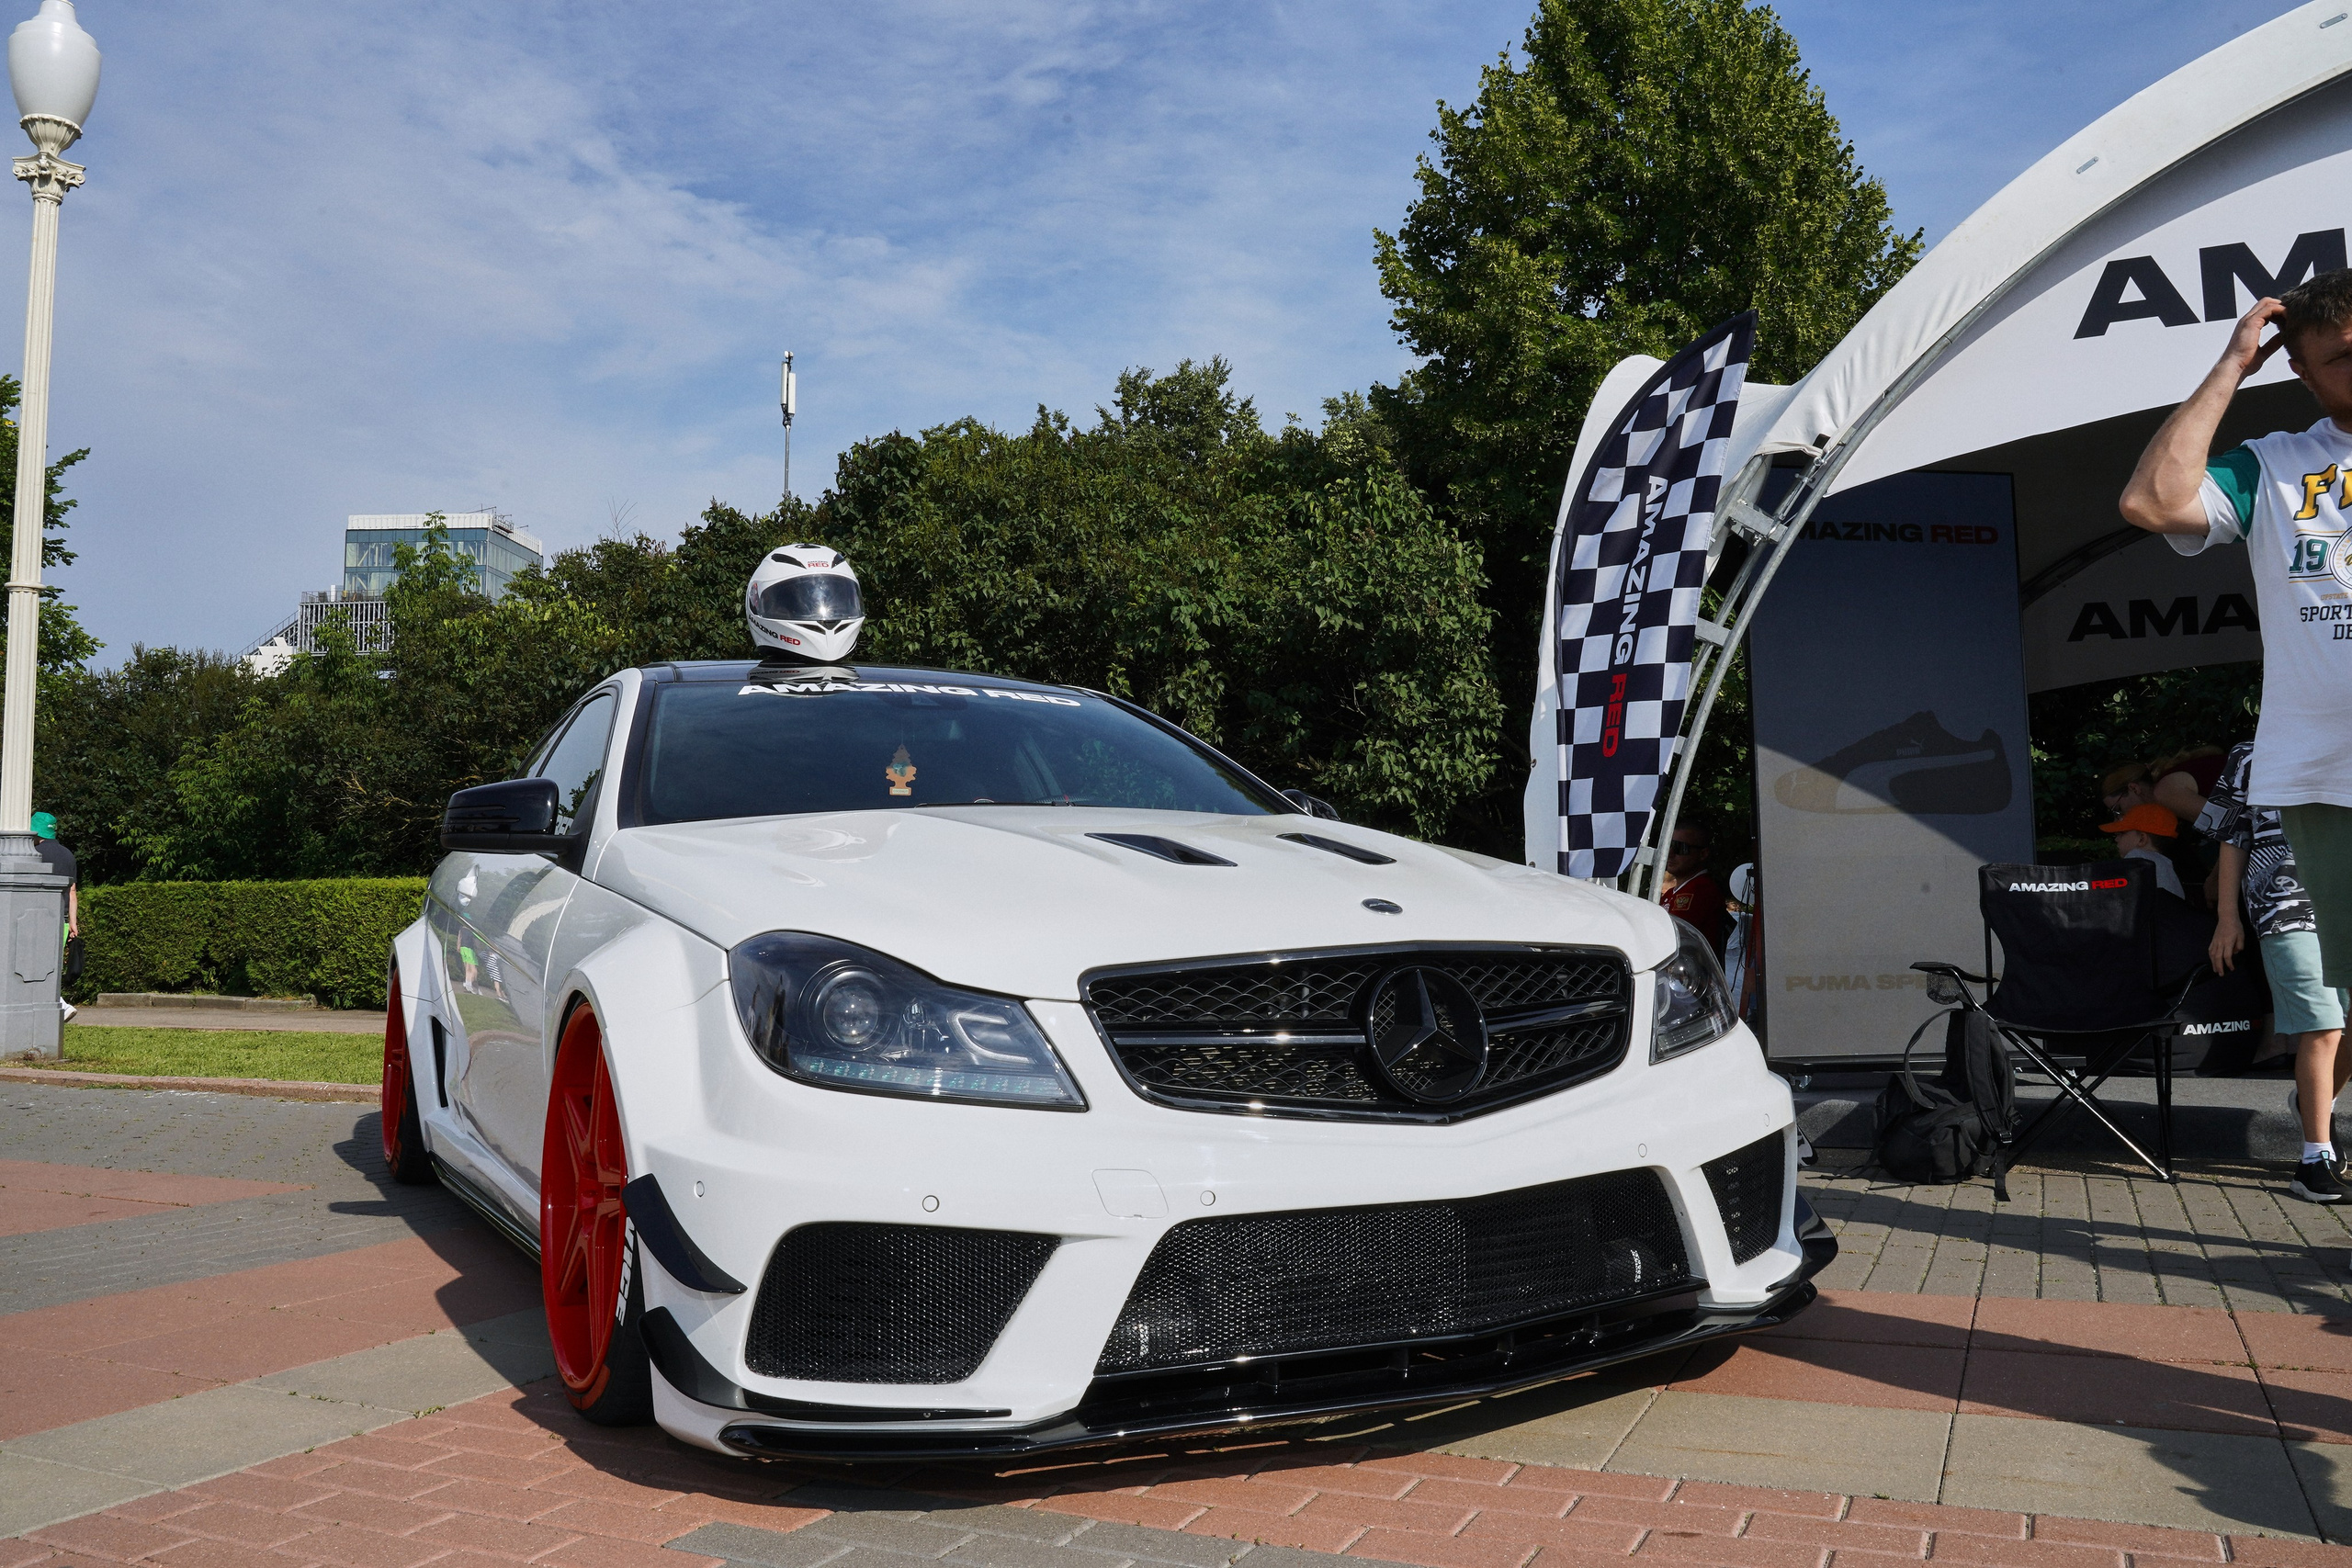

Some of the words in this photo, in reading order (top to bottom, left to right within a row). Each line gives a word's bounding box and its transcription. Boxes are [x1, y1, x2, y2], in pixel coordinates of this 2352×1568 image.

[1798, 521, 1924, 543] MAZING
[1930, 525, 1999, 545] RED
[1614, 475, 1668, 666] AMAZING
[2300, 604, 2352, 623] SPORT
[749, 615, 778, 639] AMAZING
[780, 634, 801, 646] RED
[738, 682, 978, 696] AMAZING
[982, 689, 1081, 707] RED
[1602, 673, 1627, 758] RED
[2008, 881, 2089, 892] AMAZING
[2091, 878, 2128, 890] RED
[1786, 974, 1872, 992] PUMA
[2183, 1020, 2250, 1036] AMAZING
